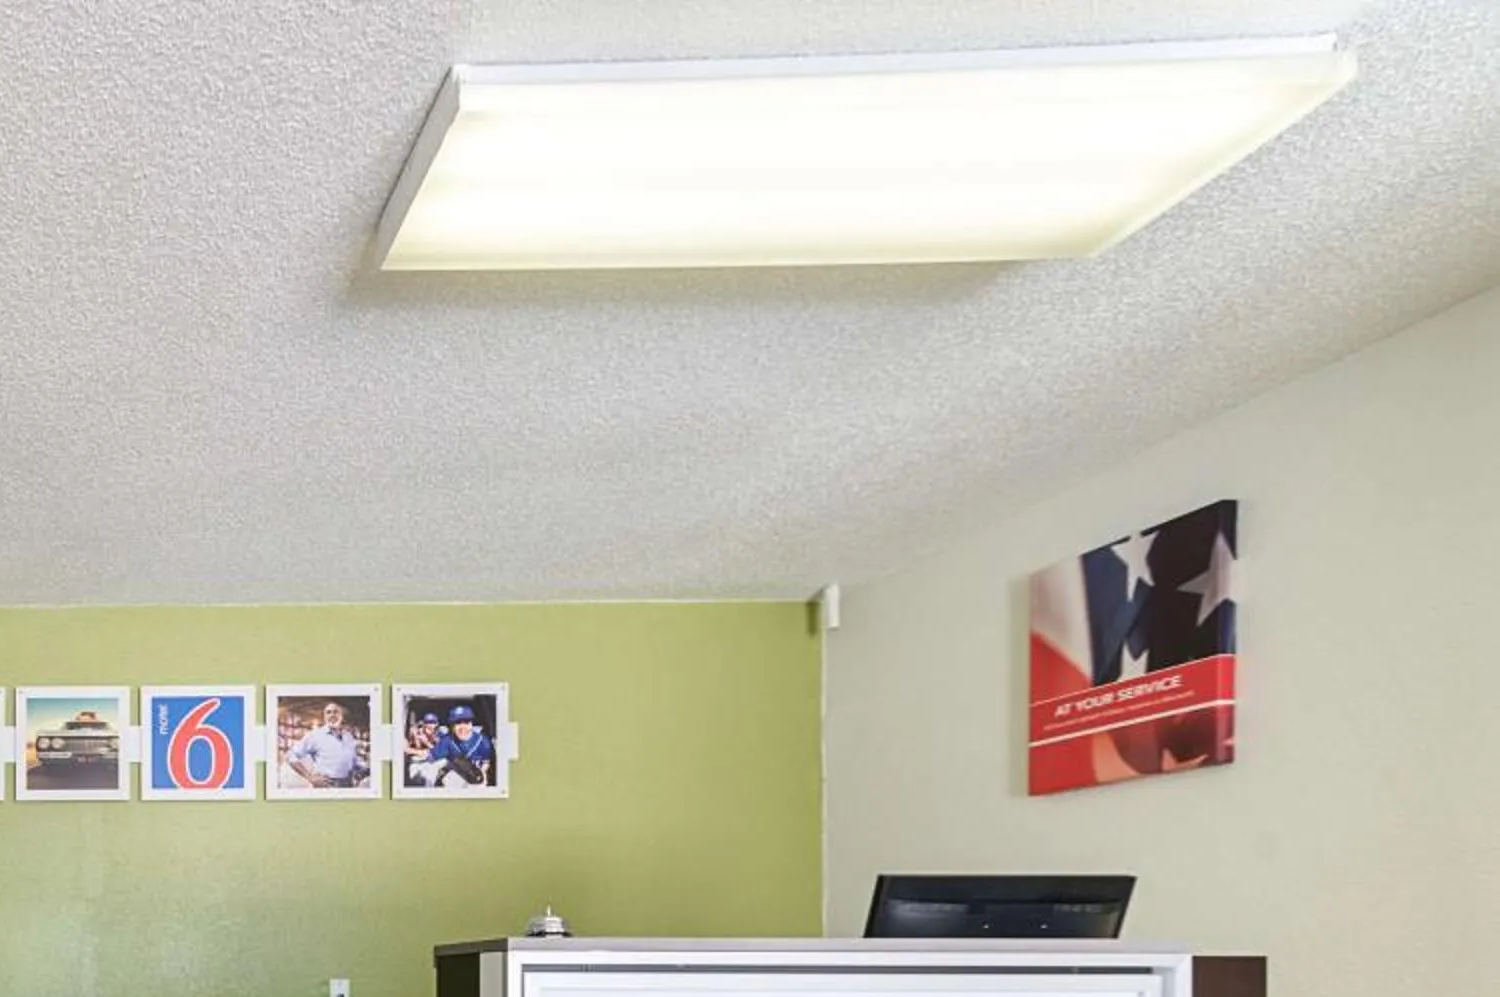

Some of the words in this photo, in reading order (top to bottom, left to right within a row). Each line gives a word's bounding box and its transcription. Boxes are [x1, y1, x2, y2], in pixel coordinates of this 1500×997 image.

[1054, 702, 1071, 717] AT
[1074, 692, 1114, 711] YOUR
[1116, 675, 1183, 702] SERVICE
[167, 698, 234, 790] 6
